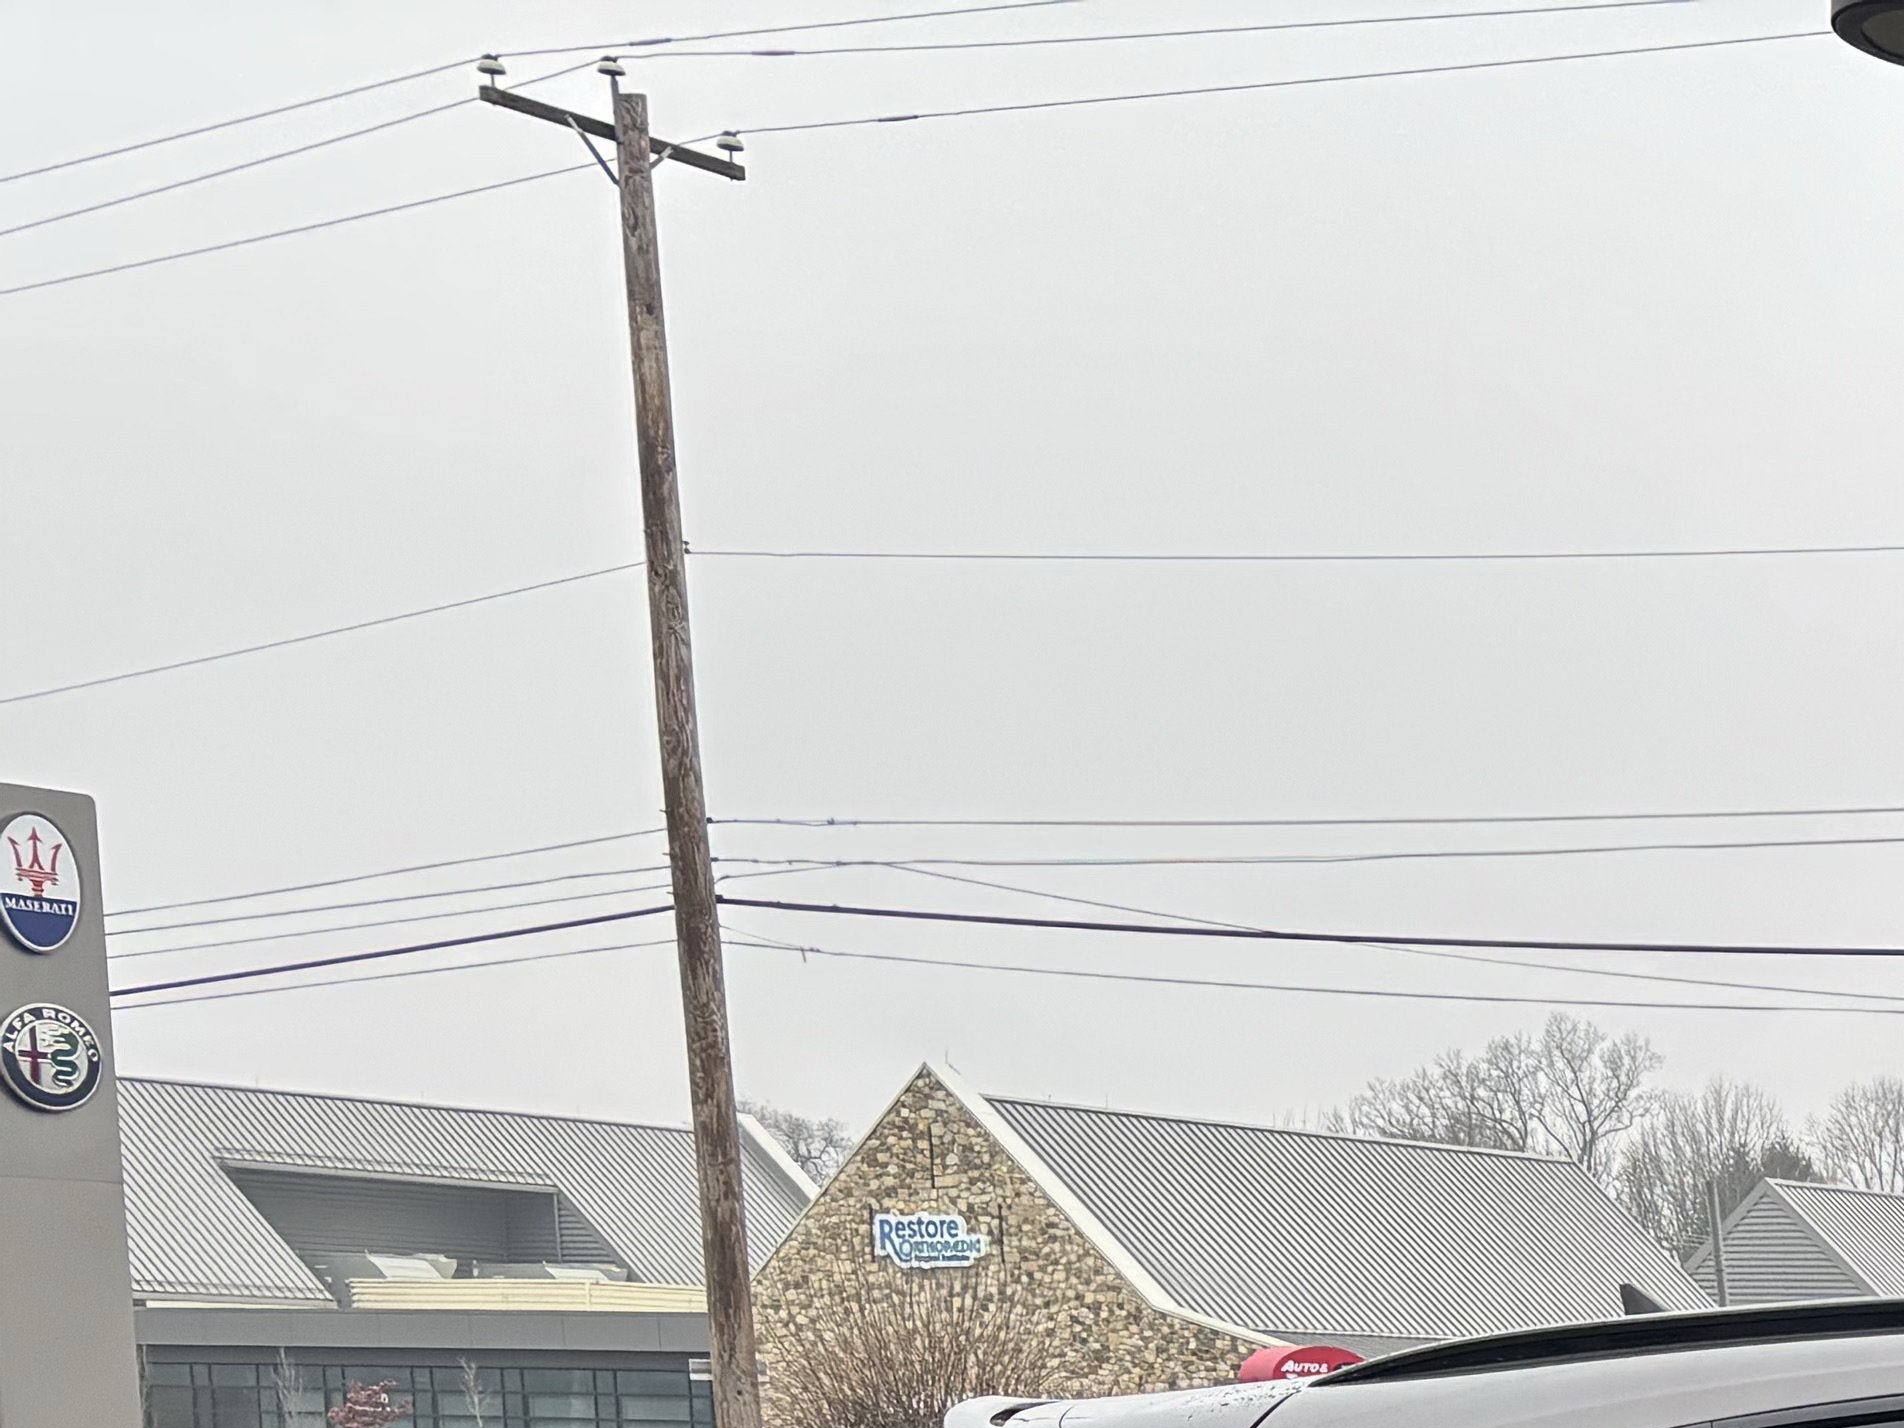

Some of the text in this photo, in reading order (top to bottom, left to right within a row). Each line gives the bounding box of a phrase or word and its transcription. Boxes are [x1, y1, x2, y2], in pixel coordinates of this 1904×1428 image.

[5, 896, 74, 916] MASERATI
[3, 1008, 99, 1062] ALFA ROMEO
[879, 1216, 959, 1254] Restore
[1281, 1360, 1319, 1373] AUTO
